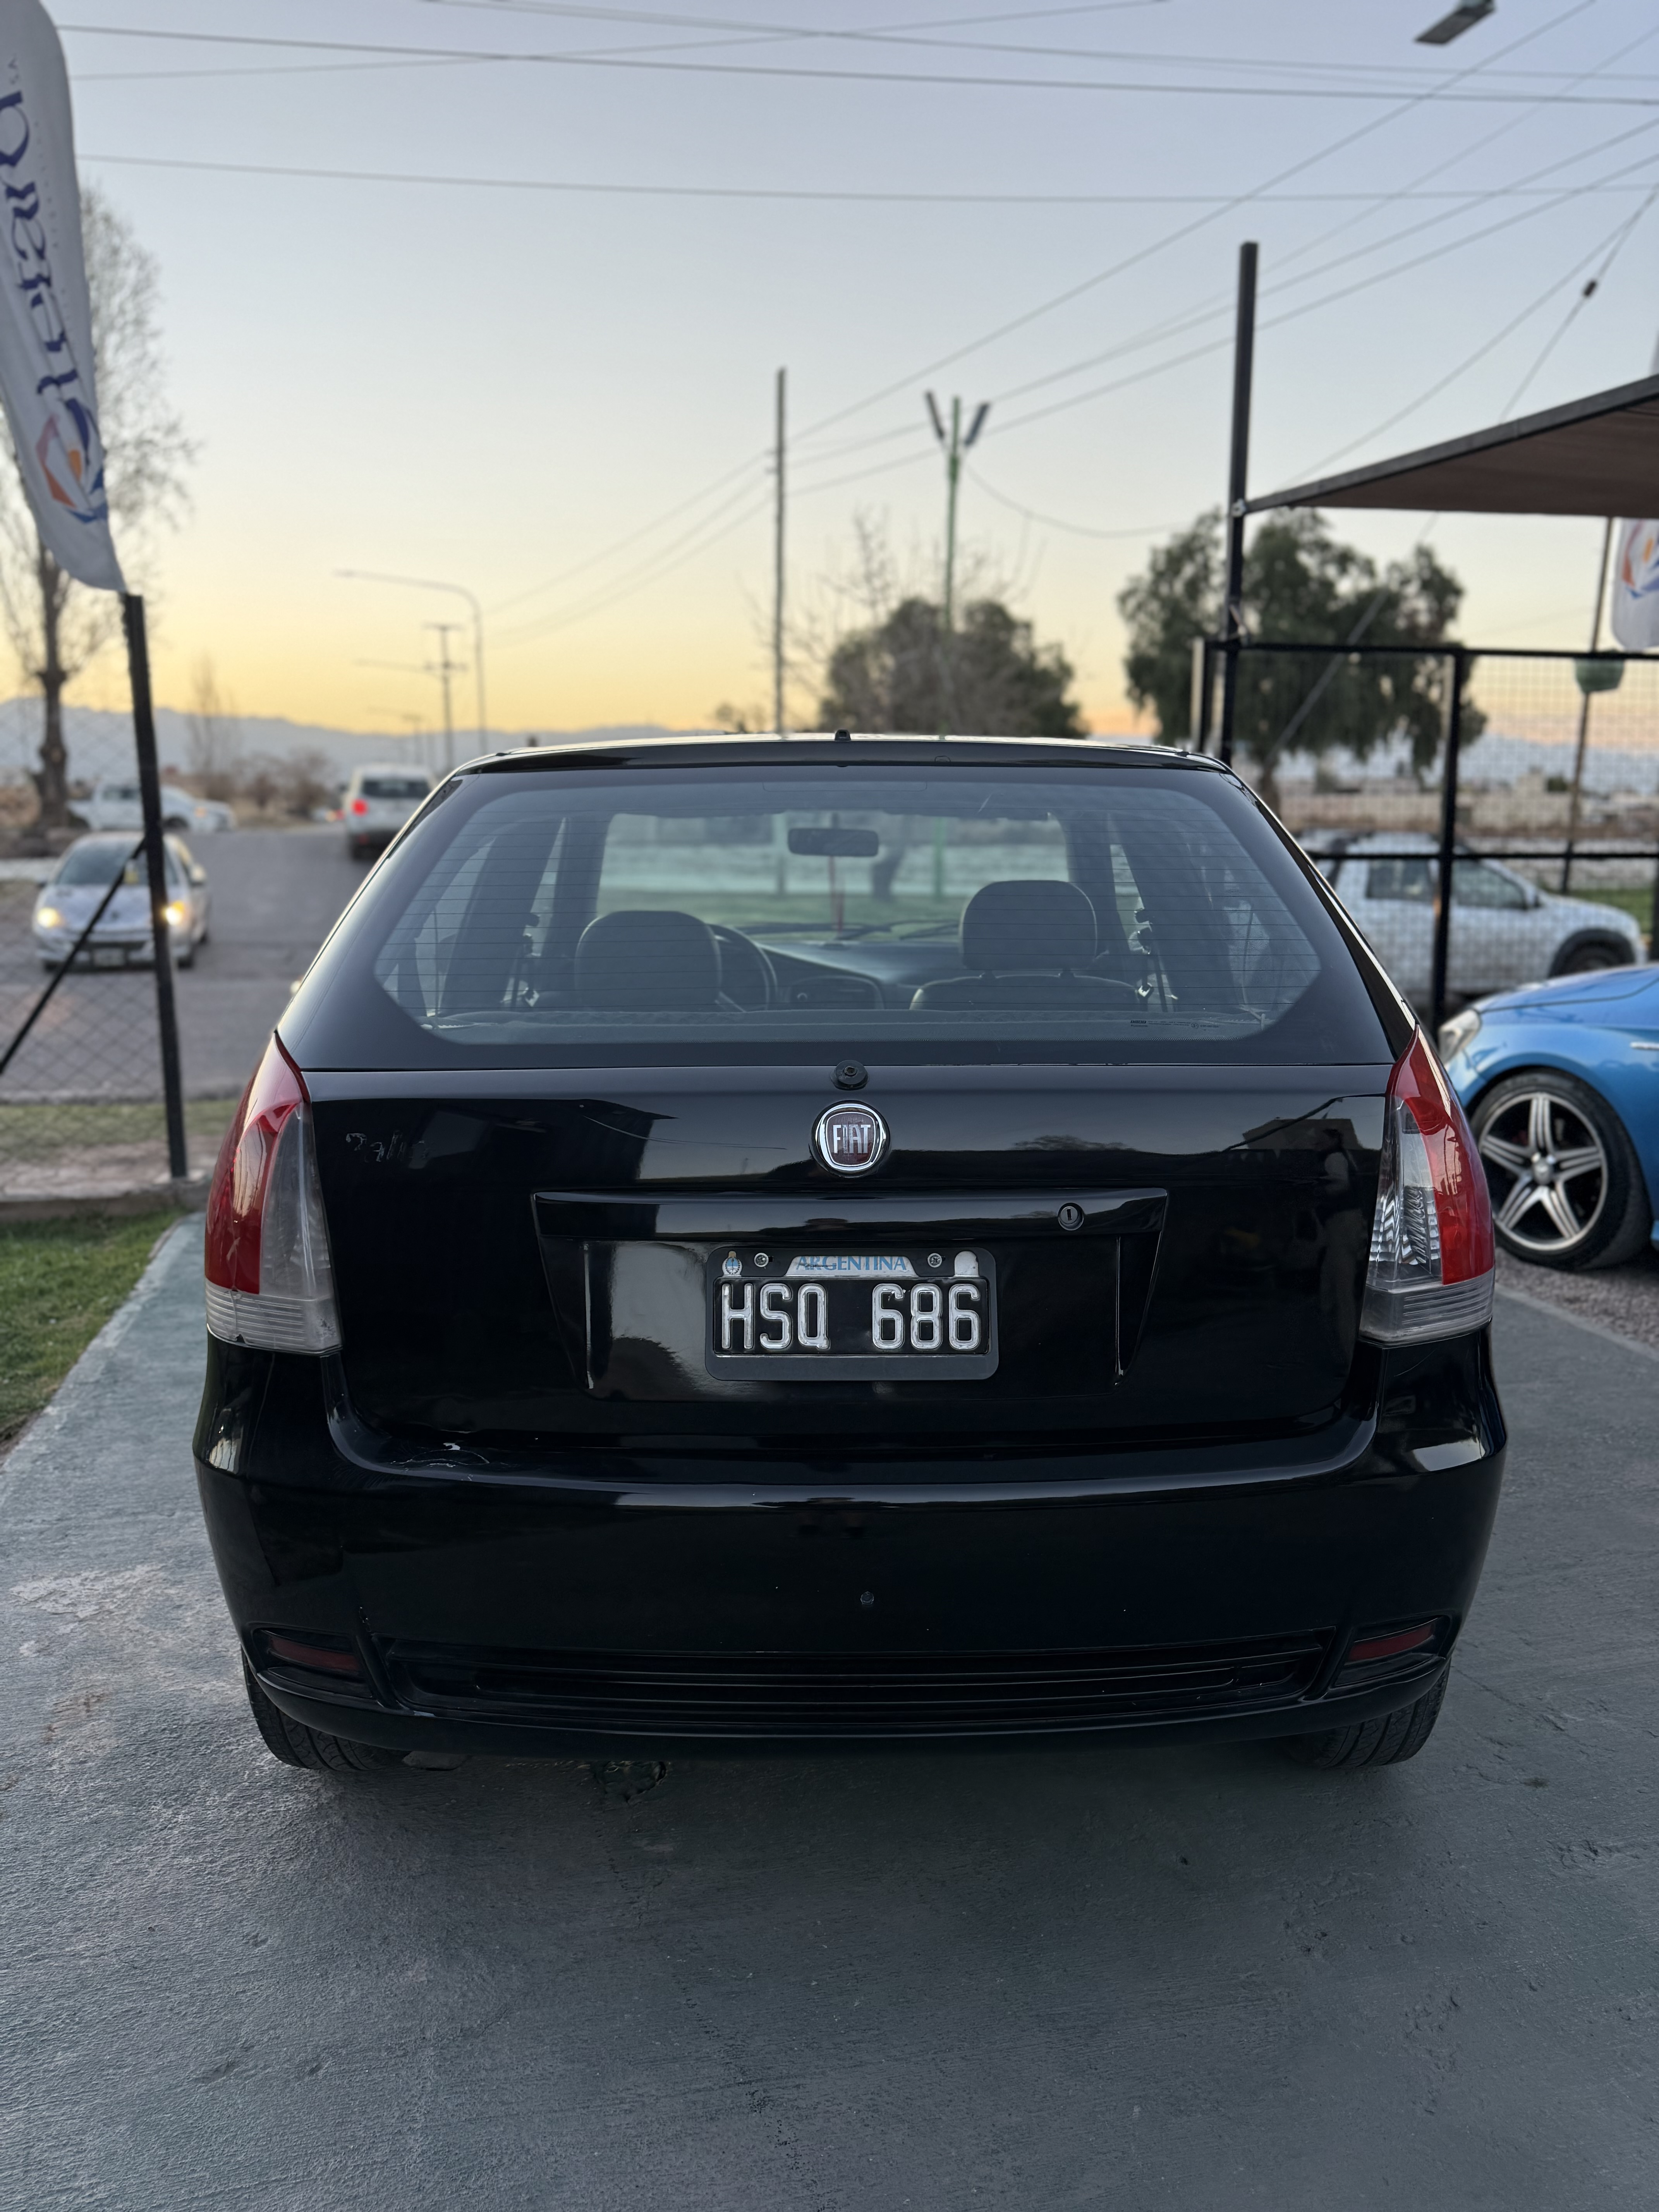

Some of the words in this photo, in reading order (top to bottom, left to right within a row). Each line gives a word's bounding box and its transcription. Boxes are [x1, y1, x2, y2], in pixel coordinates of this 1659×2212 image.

[833, 1124, 871, 1154] FIAT
[796, 1256, 907, 1271] ARGENTINA
[721, 1283, 831, 1350] HSQ
[872, 1283, 981, 1350] 686
